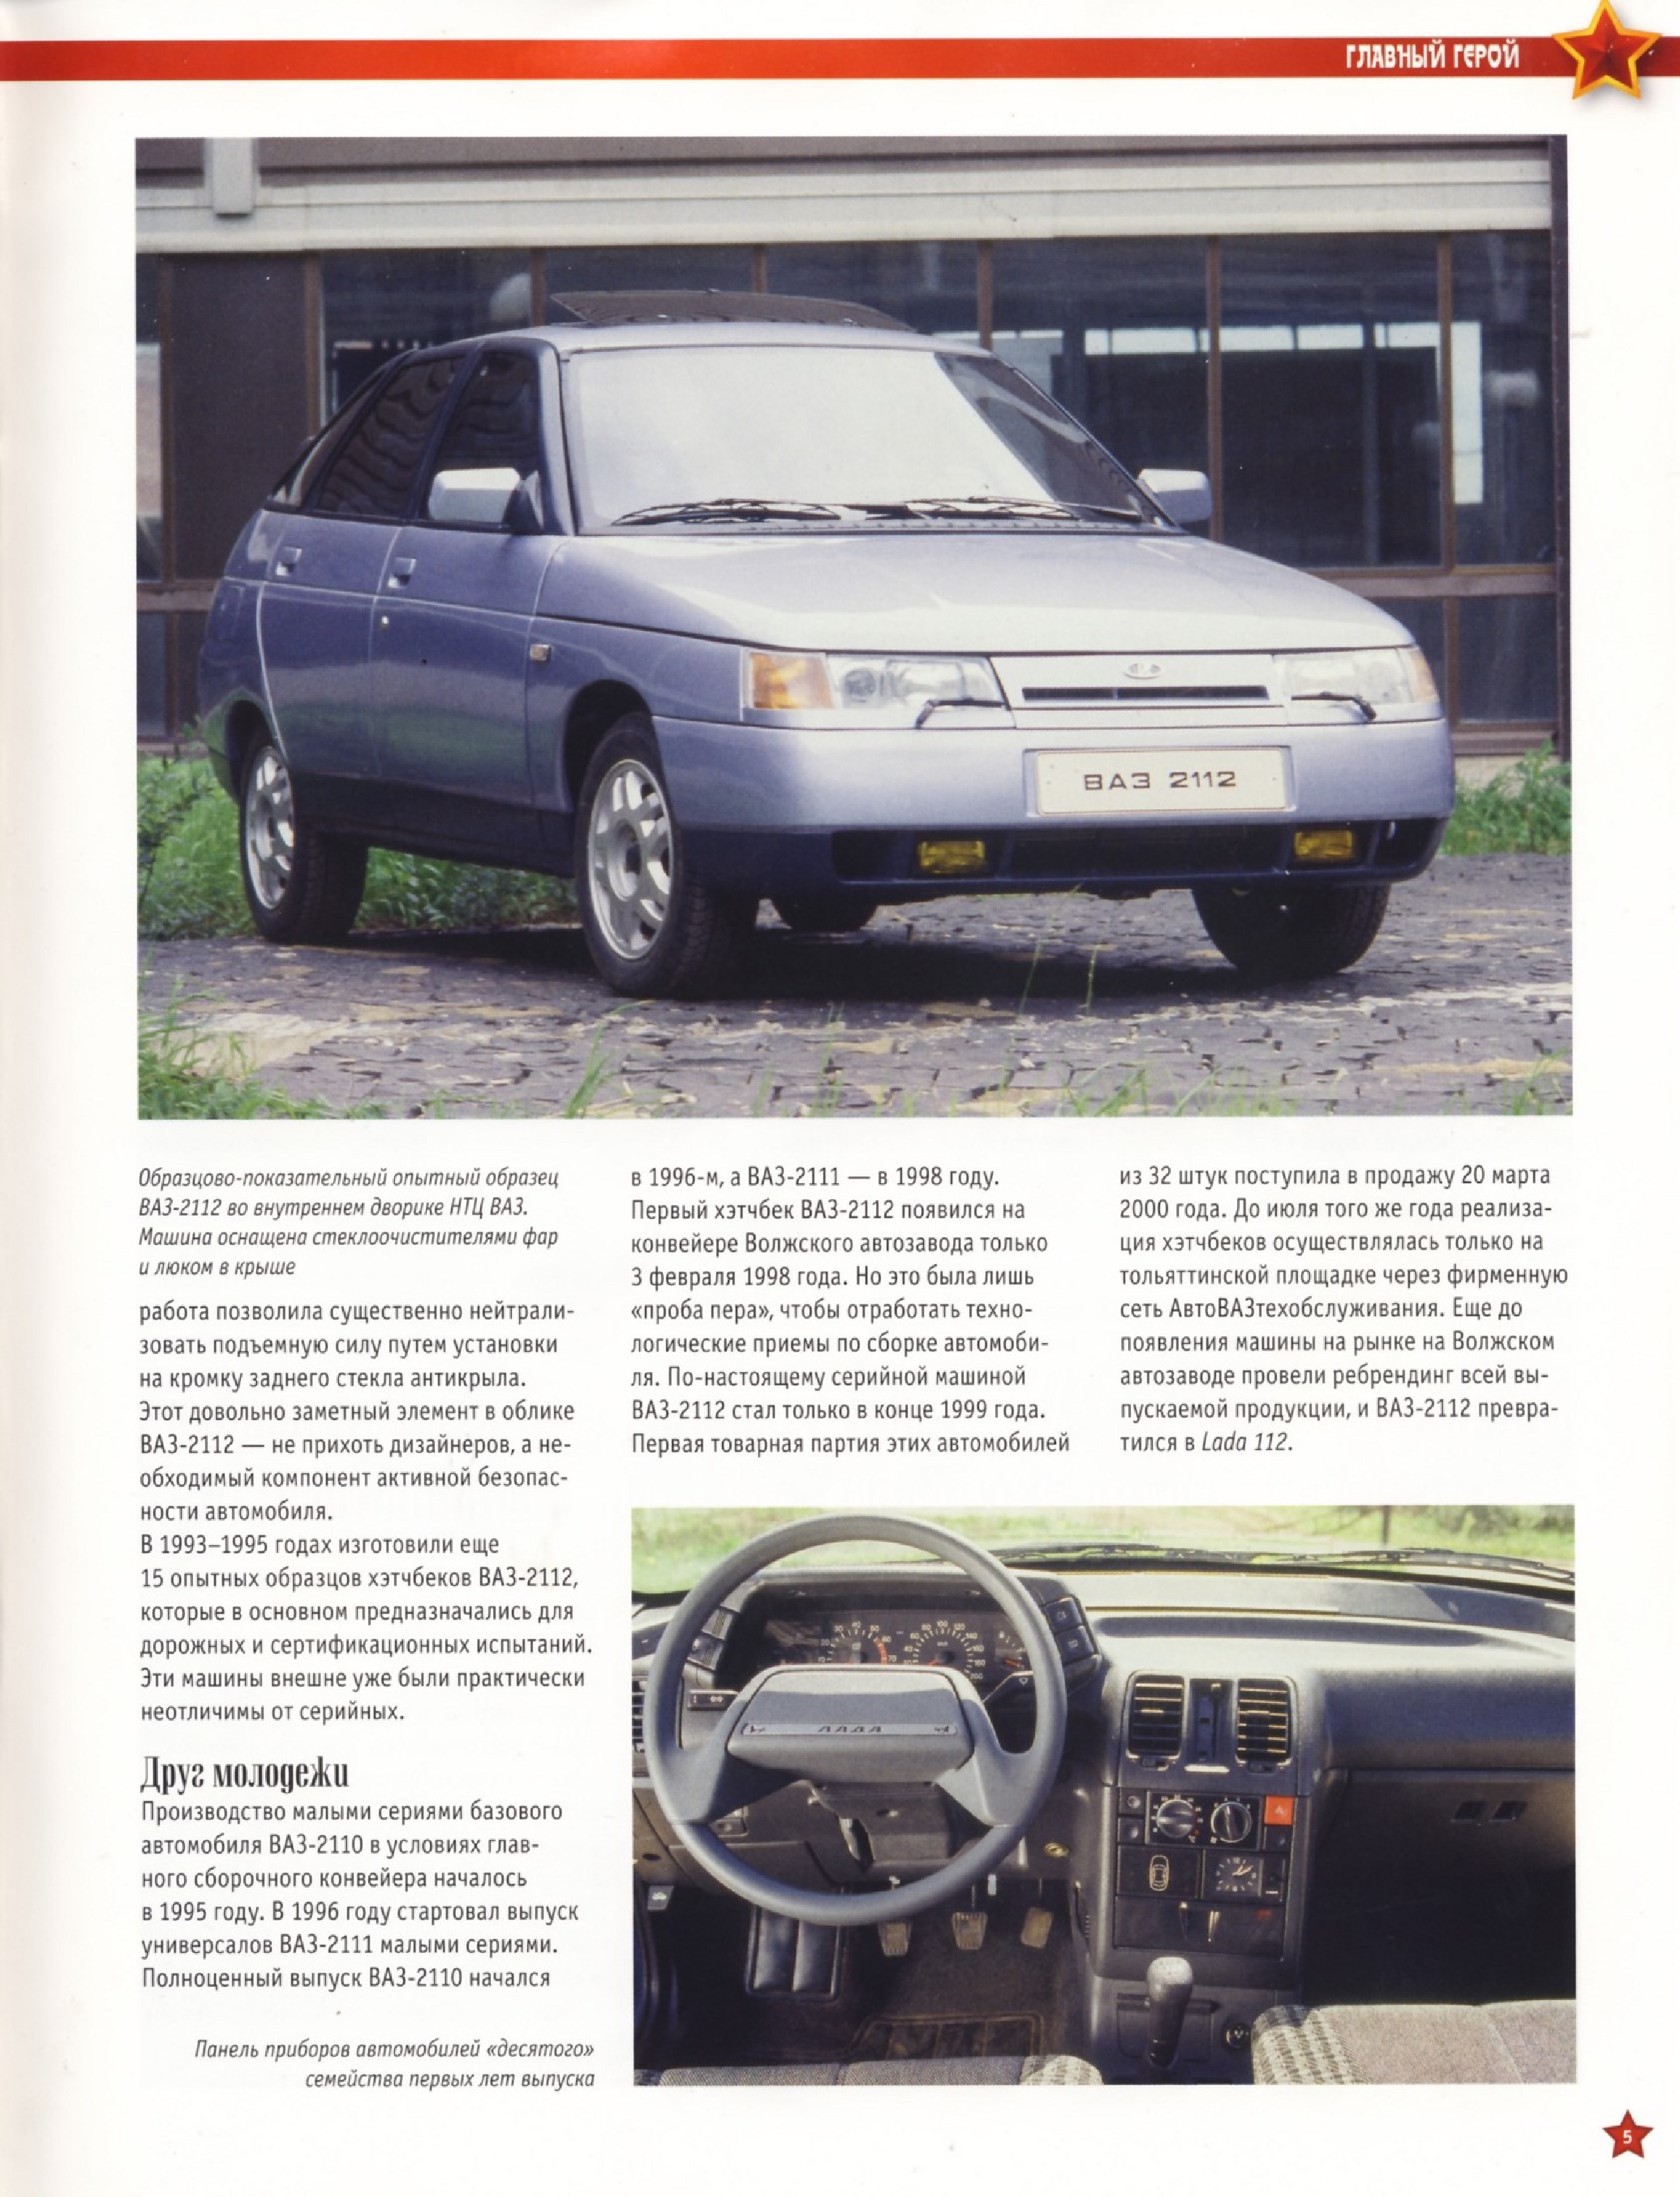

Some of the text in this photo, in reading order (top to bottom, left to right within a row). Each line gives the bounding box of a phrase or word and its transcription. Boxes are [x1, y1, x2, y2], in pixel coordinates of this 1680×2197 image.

[1346, 38, 1519, 69] ГЛАВНЫЙ ГЕРОЙ
[1084, 771, 1237, 790] ВАЗ 2112
[139, 1166, 559, 1192] Образцово-показательный опытный образец
[1120, 1164, 1550, 1190] из 32 штук поступила в продажу 20 марта
[139, 1196, 527, 1222] ВАЗ-2112 во внутреннем дворике НТЦ ВАЗ.
[631, 1197, 1025, 1225] Первый хэтчбек ВАЗ-2112 появился на
[139, 1226, 558, 1249] Машина оснащена стеклоочистителями фар
[631, 1232, 1047, 1259] конвейере Волжского автозавода только
[1120, 1229, 1543, 1256] ция хэтчбеков осуществлялась только на
[139, 1261, 296, 1280] и люком в крыше
[1119, 1263, 1568, 1289] тольяттинской площадке через фирменную
[139, 1299, 575, 1326] работа позволила существенно нейтрали-
[631, 1297, 1033, 1325] «проба пера», чтобы отработать техно-
[1120, 1296, 1522, 1323] сеть АвтоВАЗтехобслуживания. Еще до
[139, 1371, 526, 1394] на кромку заднего стекла антикрыла.
[630, 1365, 1026, 1392] ля. По-настоящему серийной машиной
[1121, 1397, 1558, 1424] пускаемой продукции, и ВАЗ-2112 превра-
[633, 1430, 1070, 1458] Первая товарная партия этих автомобилей
[1120, 1430, 1292, 1453] тился в Lada 112.
[139, 1465, 568, 1491] обходимый компонент активной безопас-
[141, 1533, 499, 1557] В 1993–1995 годах изготовили еще
[142, 1565, 578, 1592] 15 опытных образцов хэтчбеков ВАЗ-2112,
[139, 1633, 592, 1660] дорожных и сертификационных испытаний.
[139, 1755, 349, 1795] Друг молодежи
[142, 1799, 563, 1826] Производство малыми сериями базового
[142, 1866, 527, 1893] ного сборочного конвейера началось
[142, 1901, 579, 1926] в 1995 году. В 1996 году стартовал выпуск
[143, 1967, 550, 1993] Полноценный выпуск ВАЗ-2110 начался
[195, 2037, 594, 2063] Панель приборов автомобилей «десятого»
[306, 2069, 595, 2092] семейства первых лет выпуска
[1623, 2129, 1632, 2144] 5
